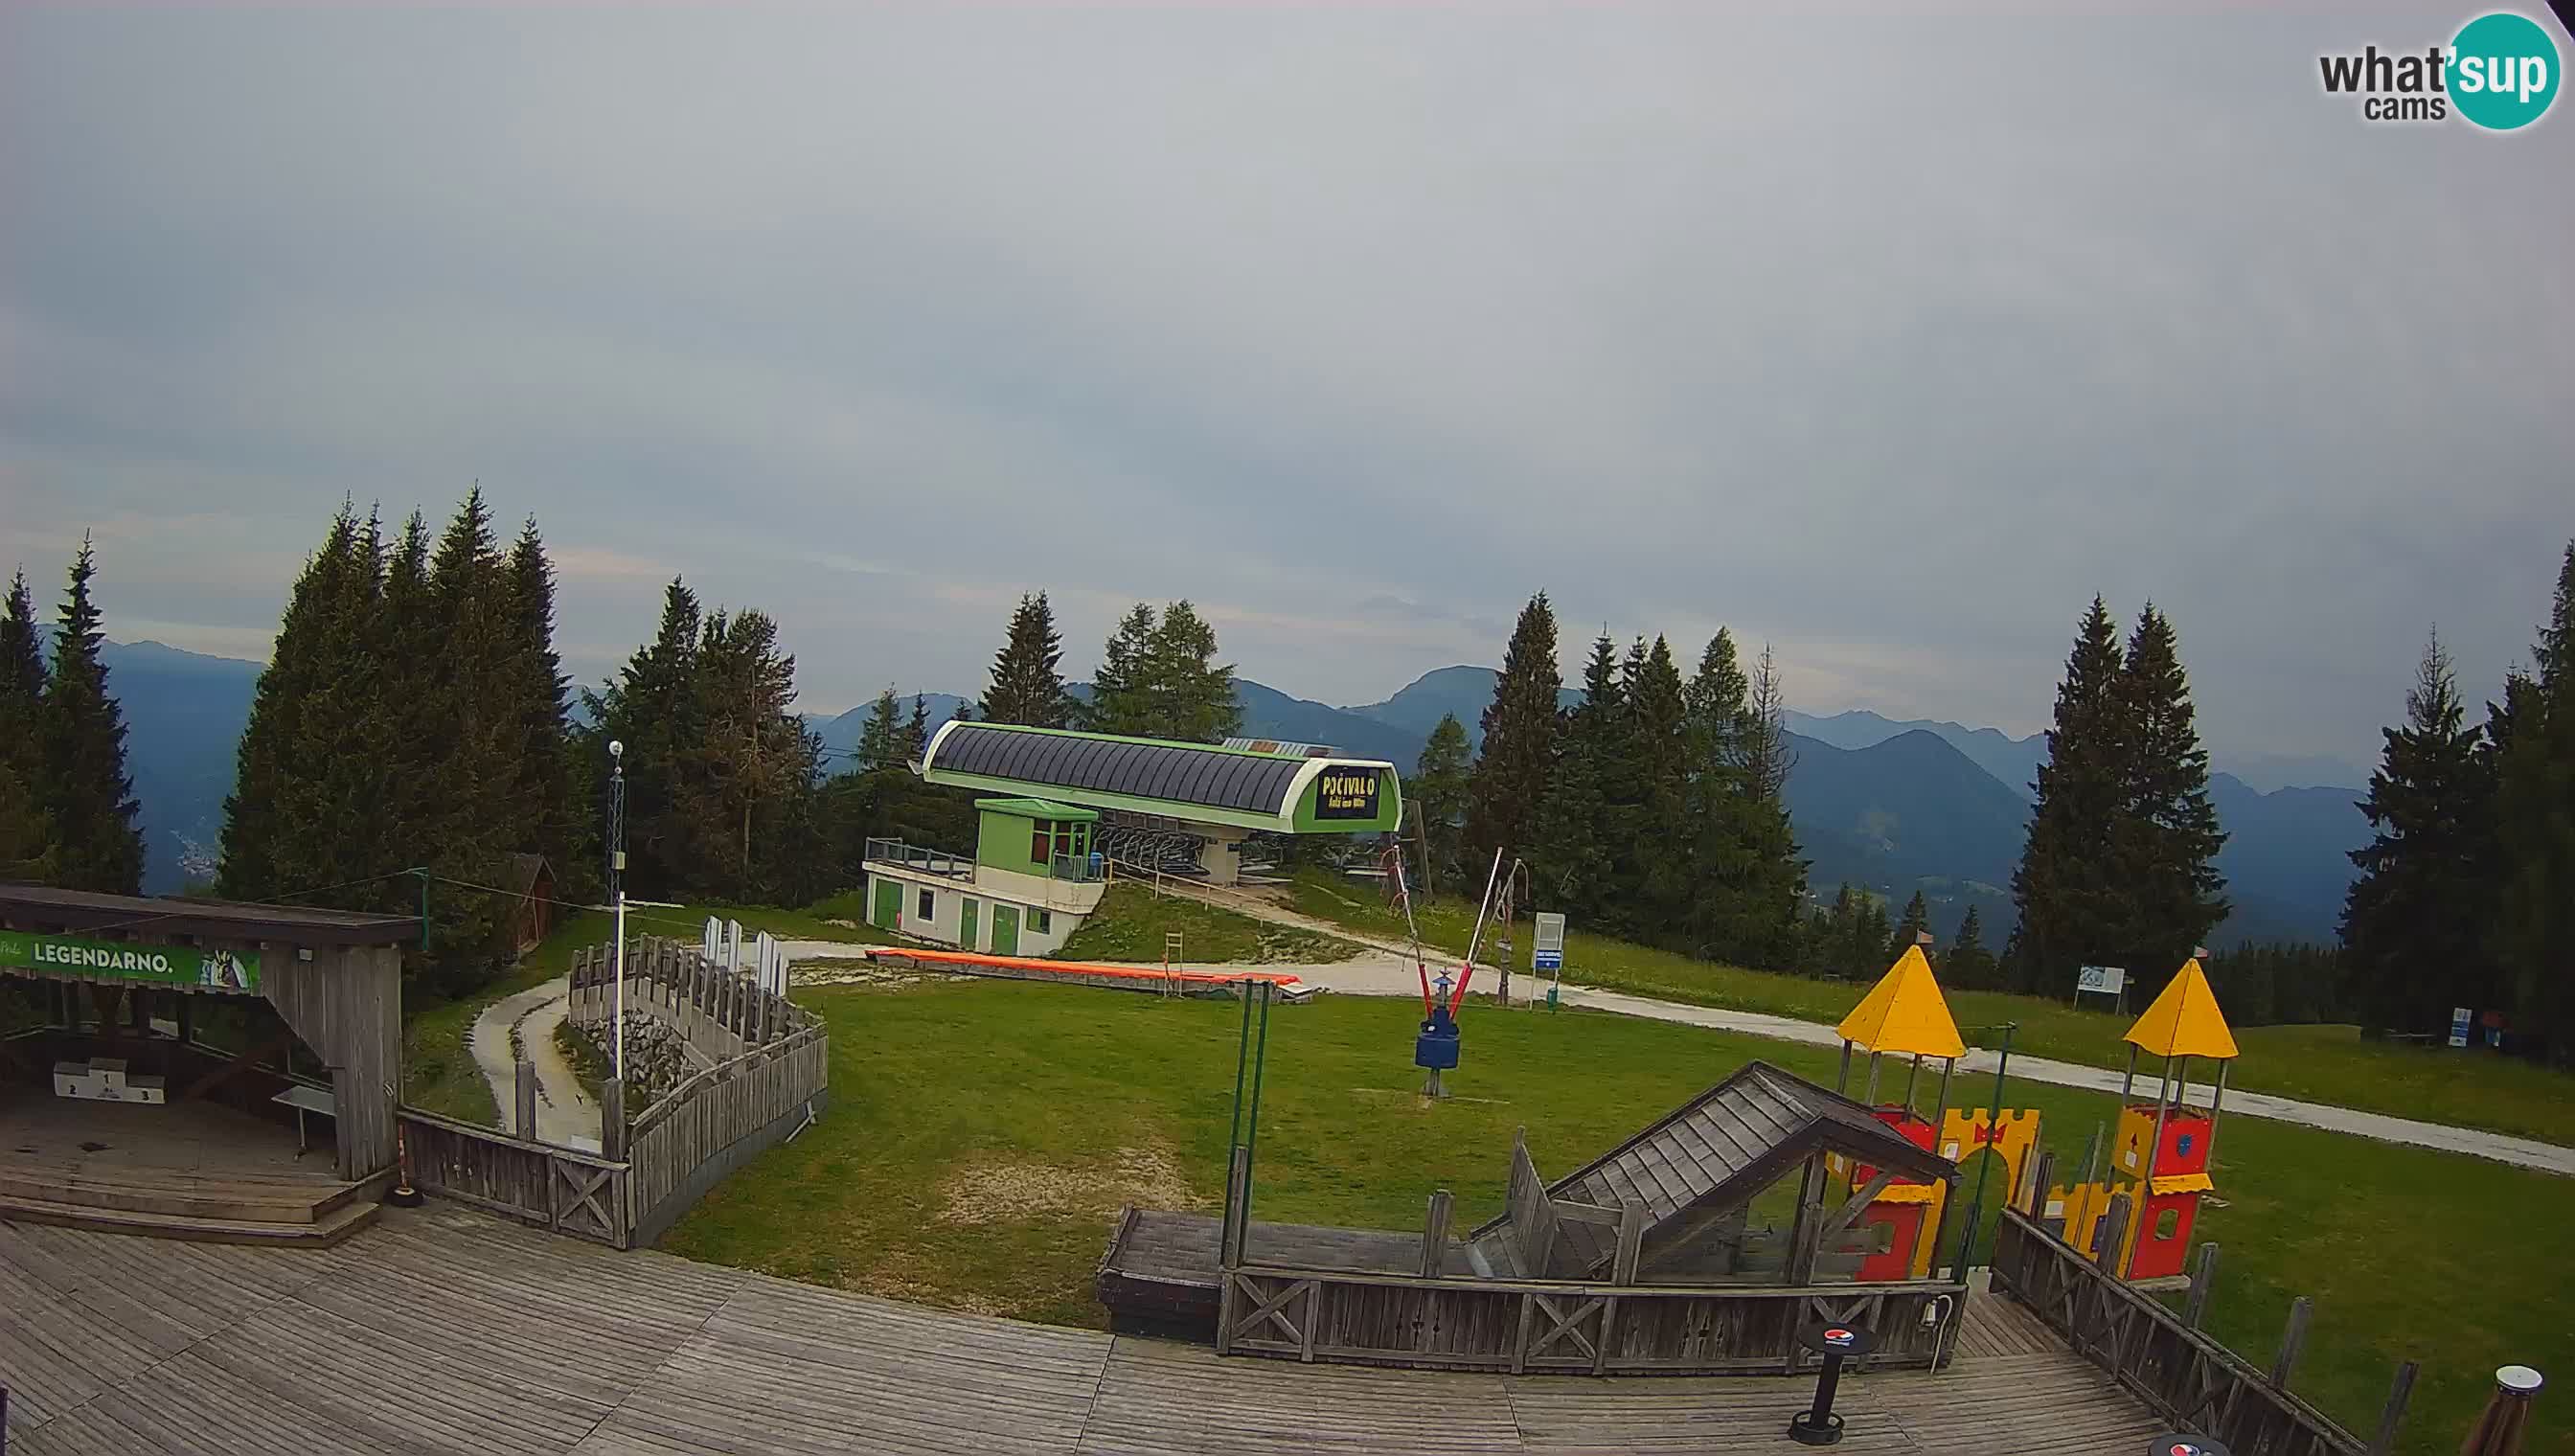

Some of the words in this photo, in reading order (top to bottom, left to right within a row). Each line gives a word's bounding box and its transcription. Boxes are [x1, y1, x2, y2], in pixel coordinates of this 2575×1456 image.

[34, 942, 174, 974] LEGENDARNO.
[103, 1073, 110, 1084] 1
[69, 1083, 78, 1096] 2
[142, 1090, 150, 1102] 3
